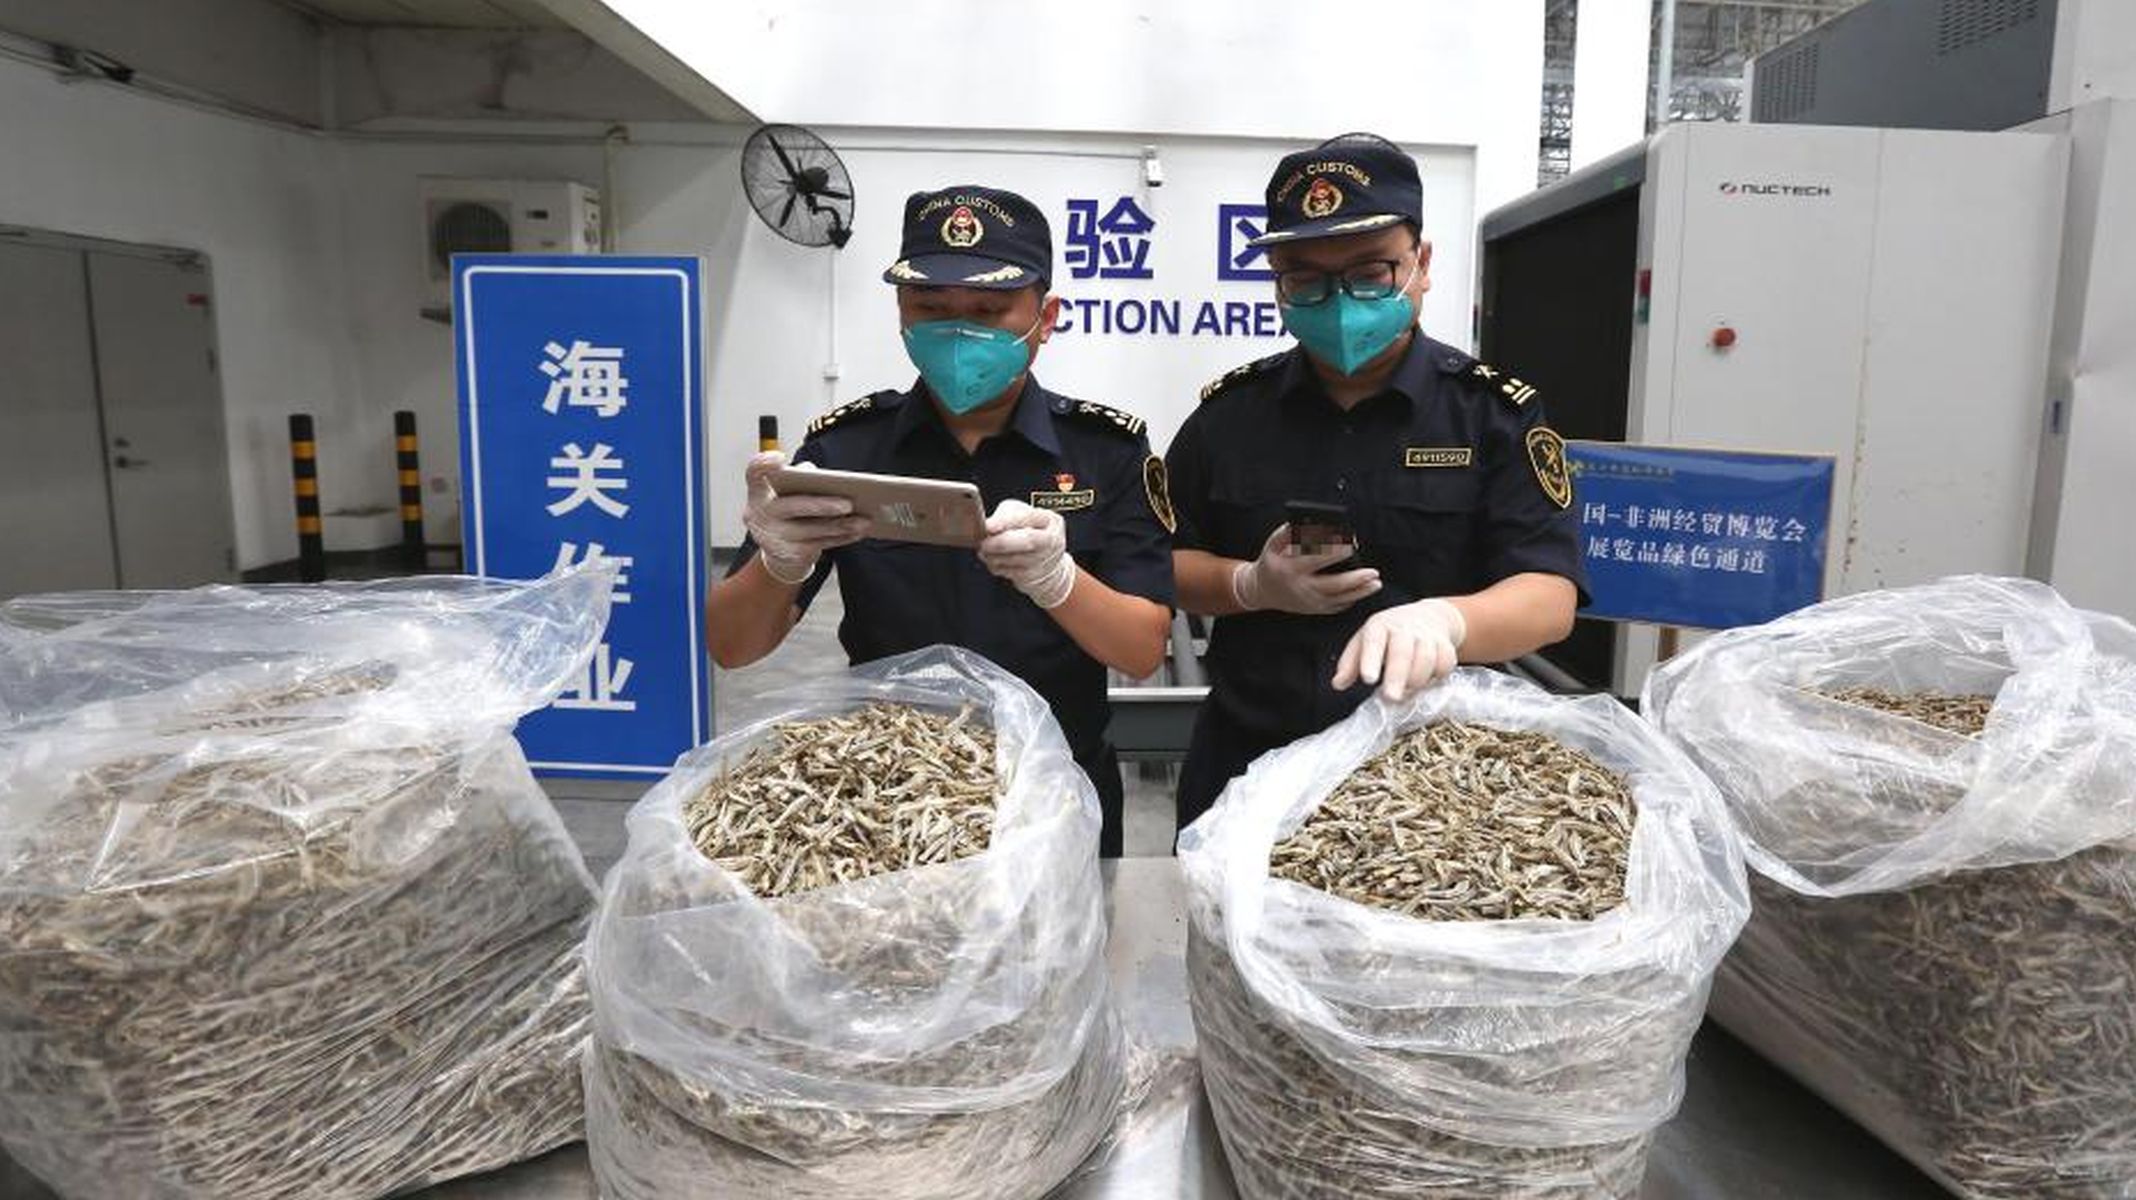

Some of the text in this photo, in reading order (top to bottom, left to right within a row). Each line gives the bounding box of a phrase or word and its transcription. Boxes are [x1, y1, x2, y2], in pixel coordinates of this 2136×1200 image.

[1307, 162, 1371, 187] CUSTOMS
[1741, 183, 1830, 197] NUCTECH
[954, 194, 1015, 228] CUSTOMS
[1192, 302, 1286, 337] ARE
[1586, 536, 1766, 575] 展览品绿色通道
